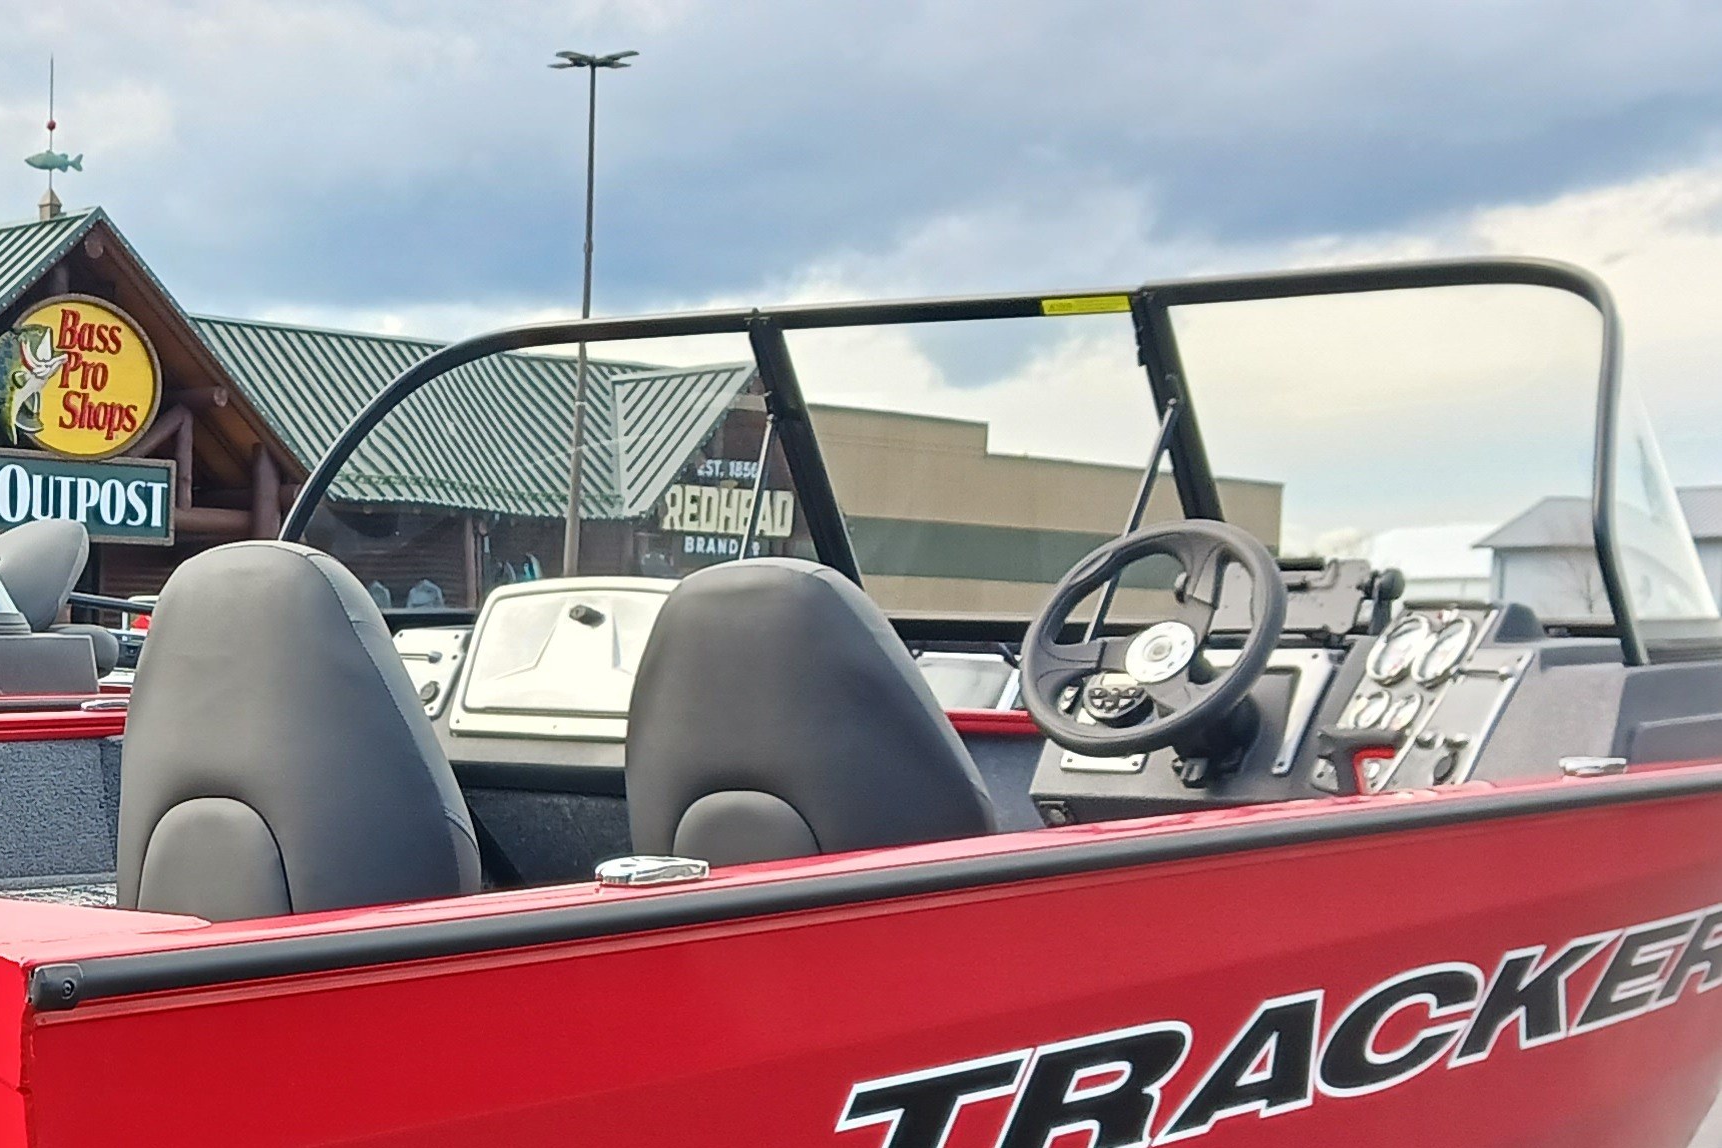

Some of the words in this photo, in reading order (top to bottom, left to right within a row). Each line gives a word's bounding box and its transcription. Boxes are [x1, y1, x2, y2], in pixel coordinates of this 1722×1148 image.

[56, 309, 122, 355] Bass
[57, 351, 109, 392] Pro
[58, 391, 139, 440] Shops
[662, 484, 795, 537] REDHEAD
[684, 536, 739, 555] BRAND
